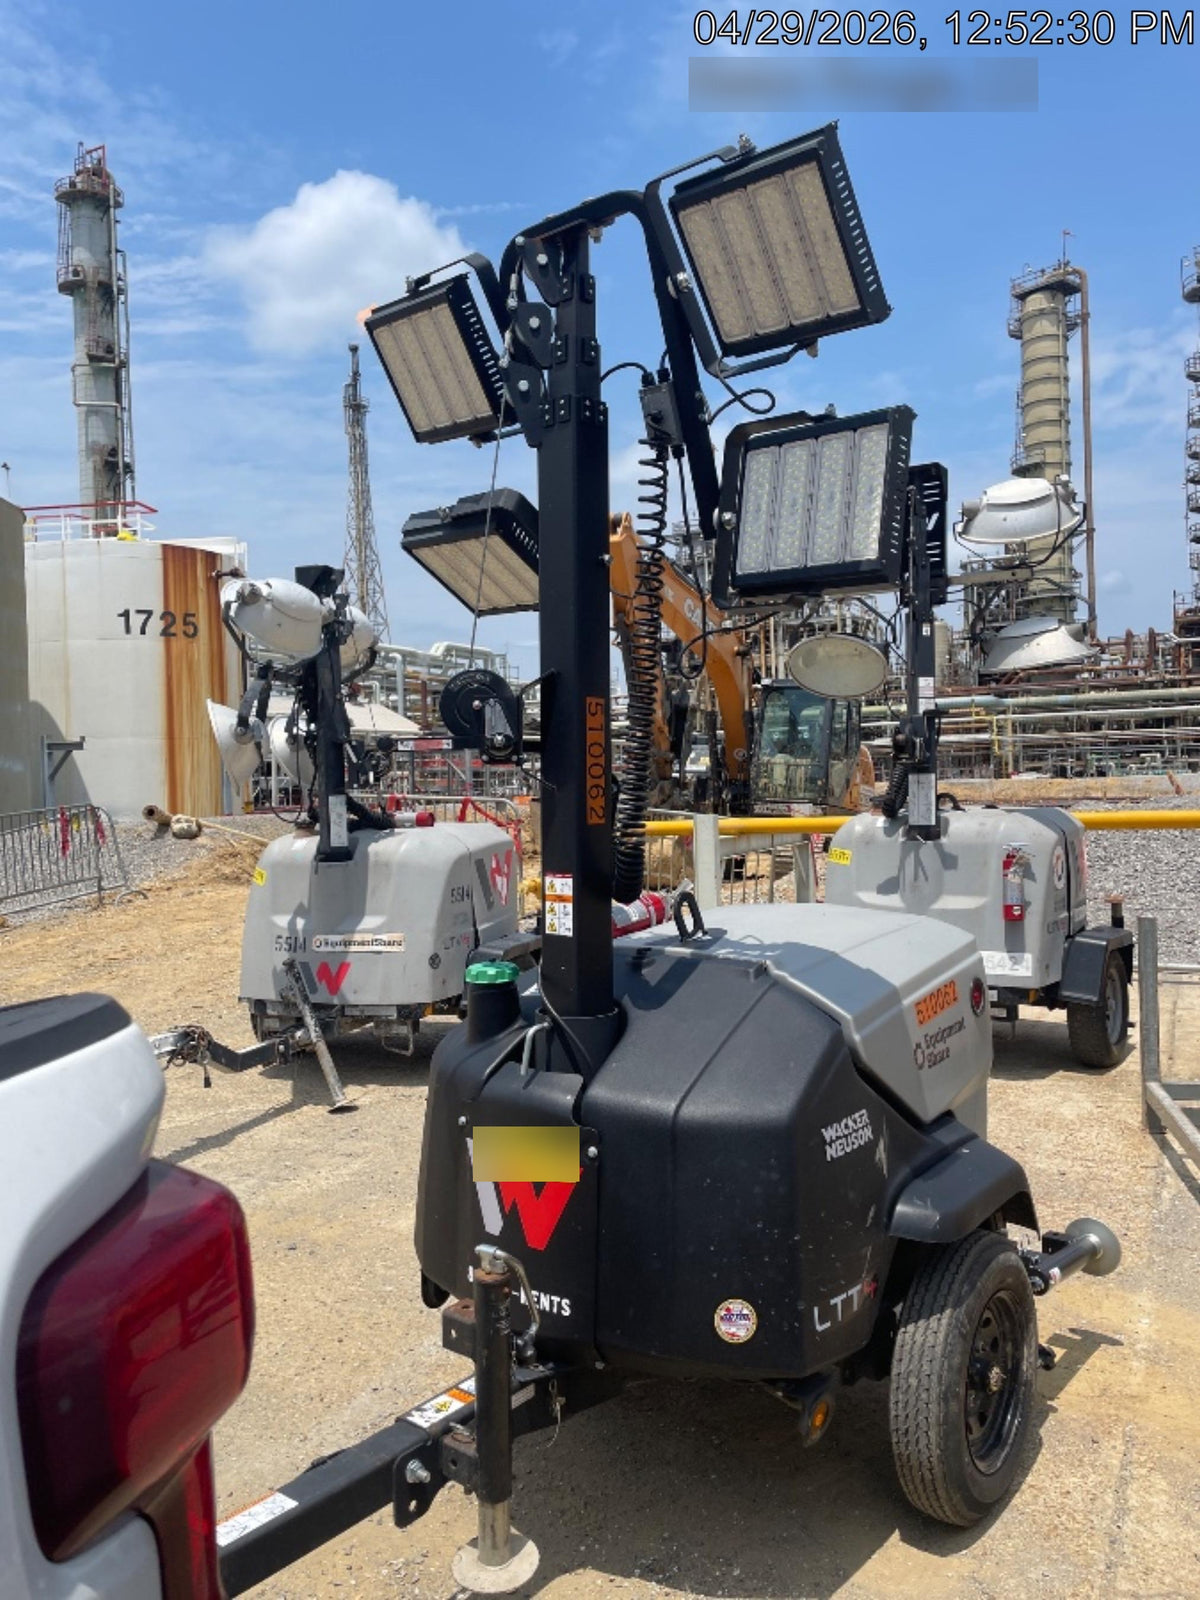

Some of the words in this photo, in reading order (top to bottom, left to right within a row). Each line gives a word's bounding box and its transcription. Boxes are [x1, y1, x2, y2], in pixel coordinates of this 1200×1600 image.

[117, 608, 199, 639] 1725
[587, 700, 605, 822] 510062
[821, 1108, 870, 1143] WACKER
[825, 1125, 874, 1161] NEUSON
